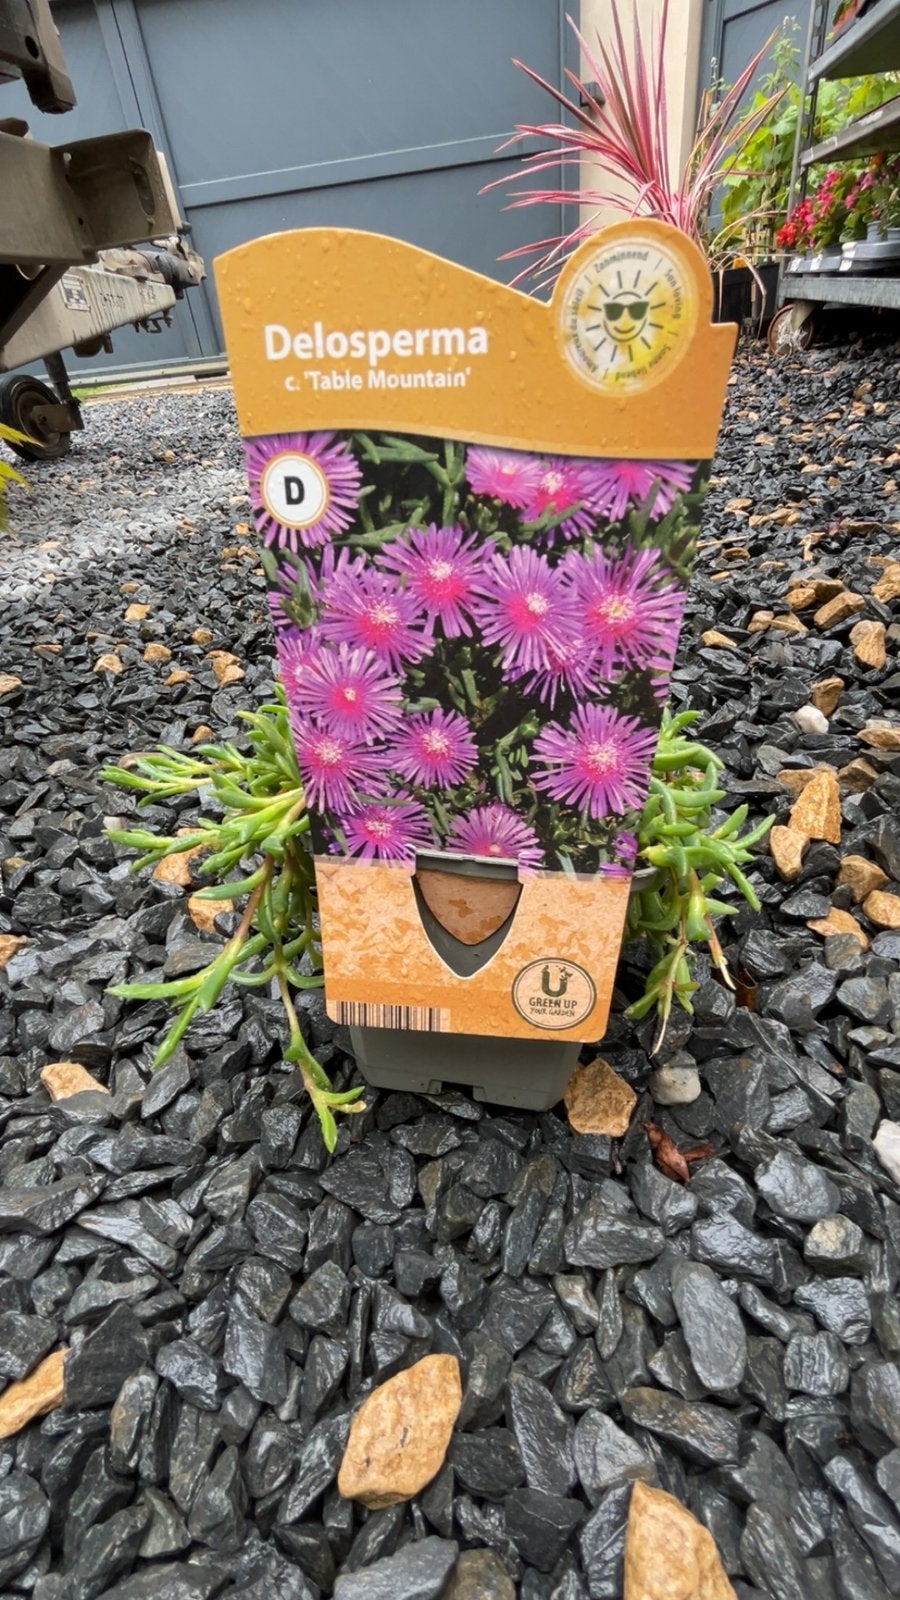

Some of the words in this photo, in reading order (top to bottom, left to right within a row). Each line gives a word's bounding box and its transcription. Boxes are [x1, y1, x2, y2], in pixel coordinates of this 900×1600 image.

[663, 268, 678, 288] Sun
[264, 321, 489, 367] Delosperma
[284, 375, 301, 392] c.
[303, 370, 363, 391] 'Table
[367, 367, 472, 390] Mountain'
[283, 475, 306, 506] D
[528, 997, 561, 1009] GREEN
[563, 1000, 578, 1009] UP
[530, 1007, 548, 1016] YOUR
[548, 1009, 576, 1017] GARDEN
